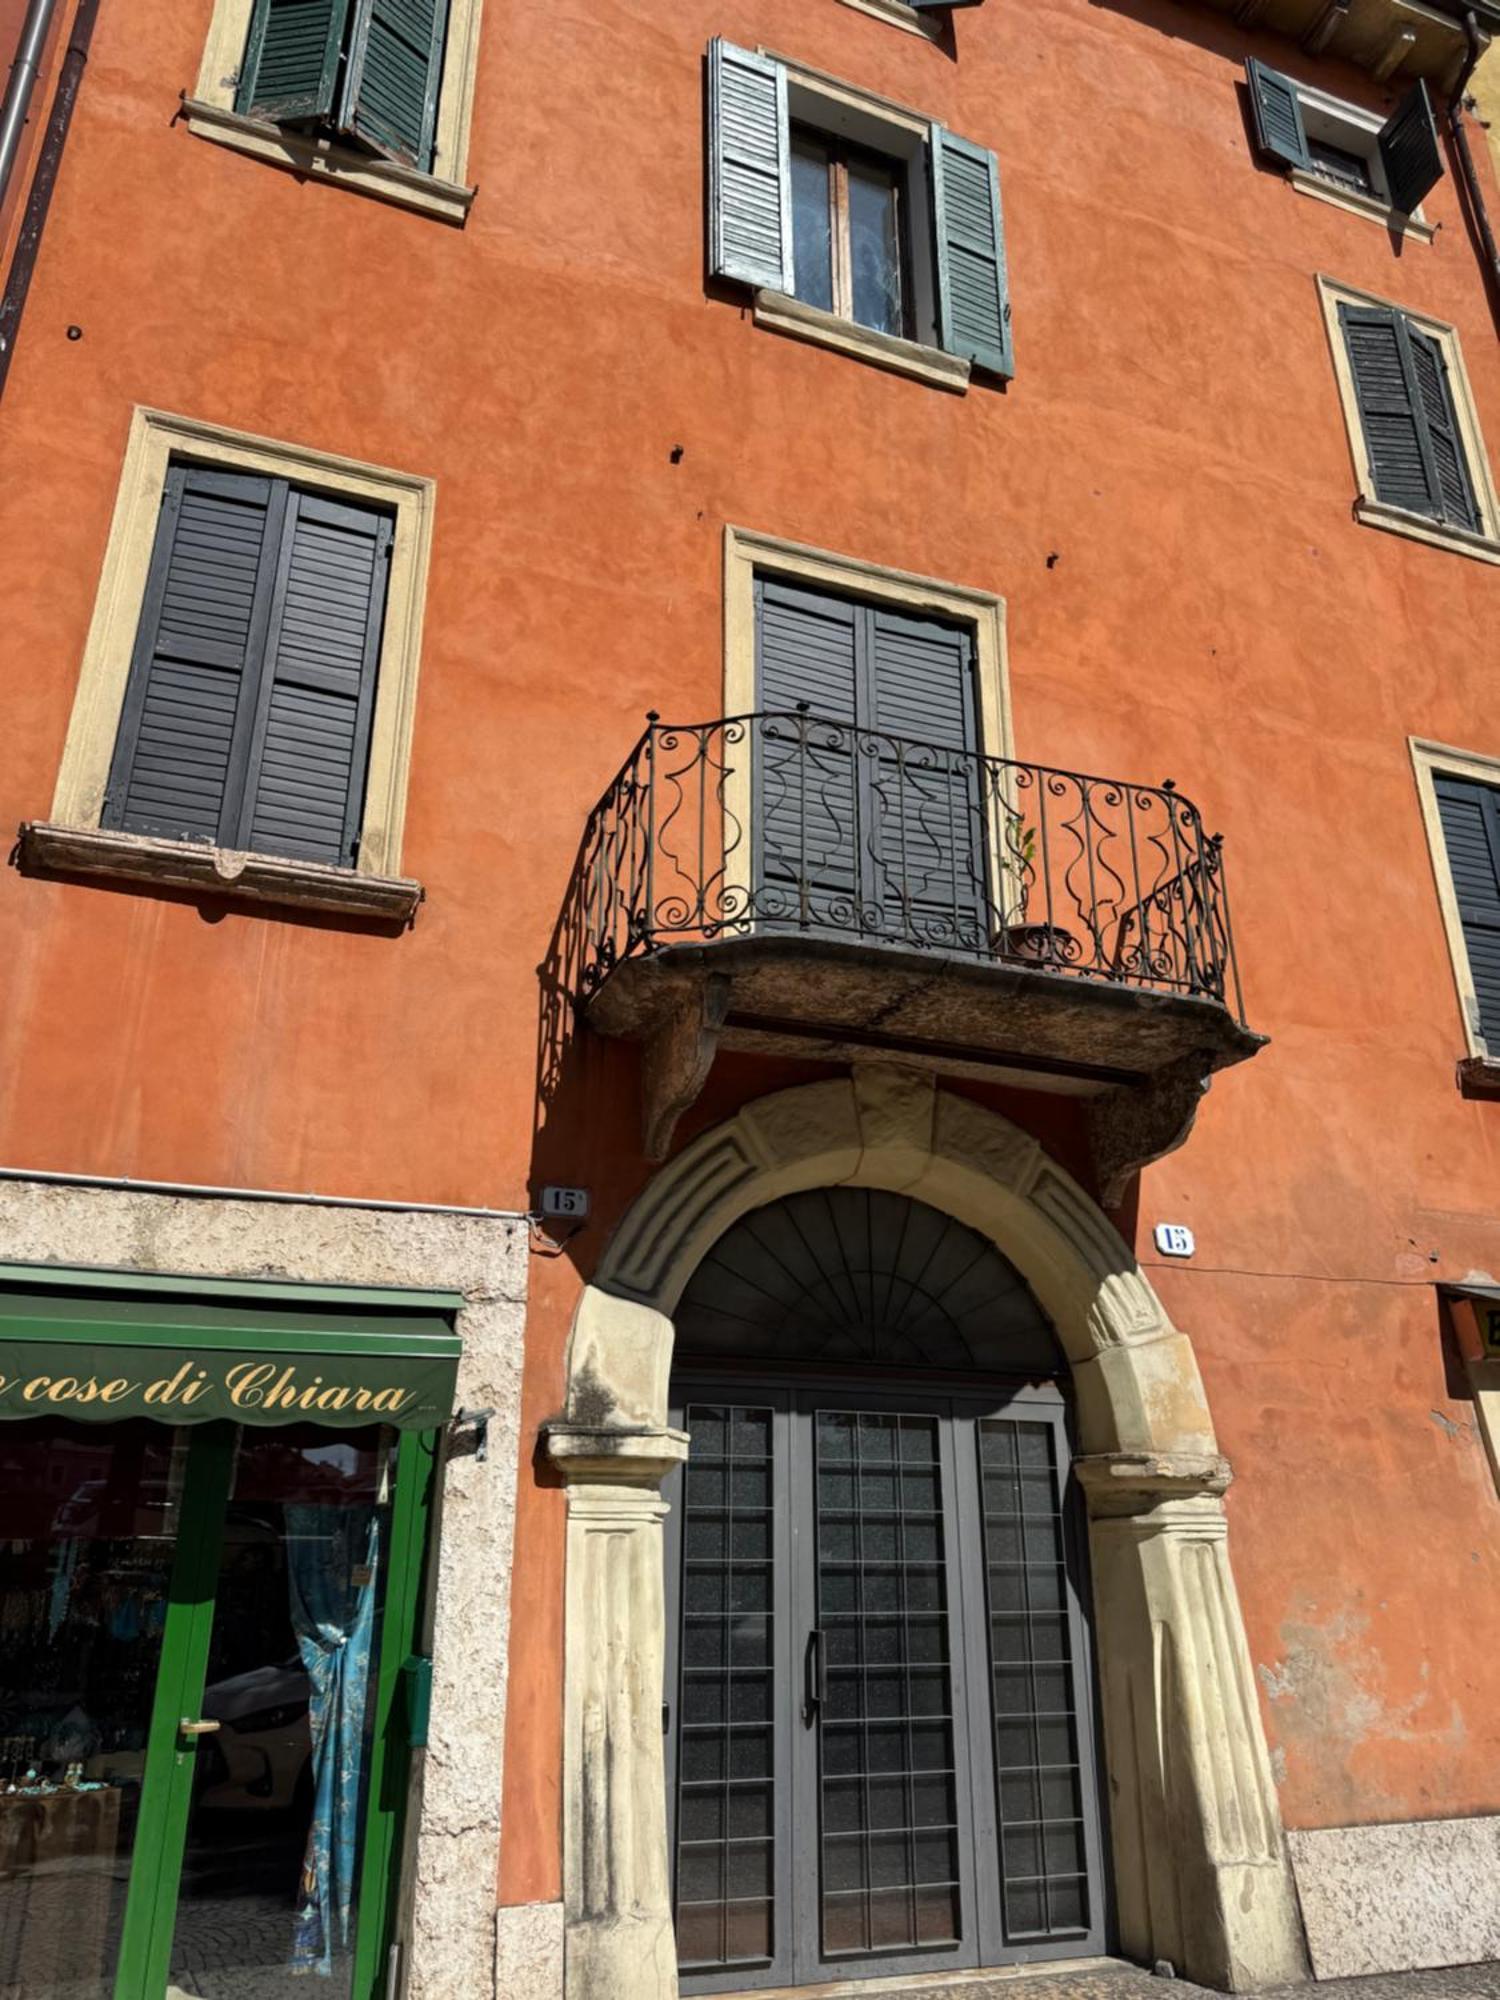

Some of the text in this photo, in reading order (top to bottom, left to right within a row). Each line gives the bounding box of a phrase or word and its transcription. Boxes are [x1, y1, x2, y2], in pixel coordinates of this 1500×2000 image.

[23, 1374, 141, 1402] cose
[143, 1361, 214, 1405] di
[225, 1362, 417, 1411] Chiara
